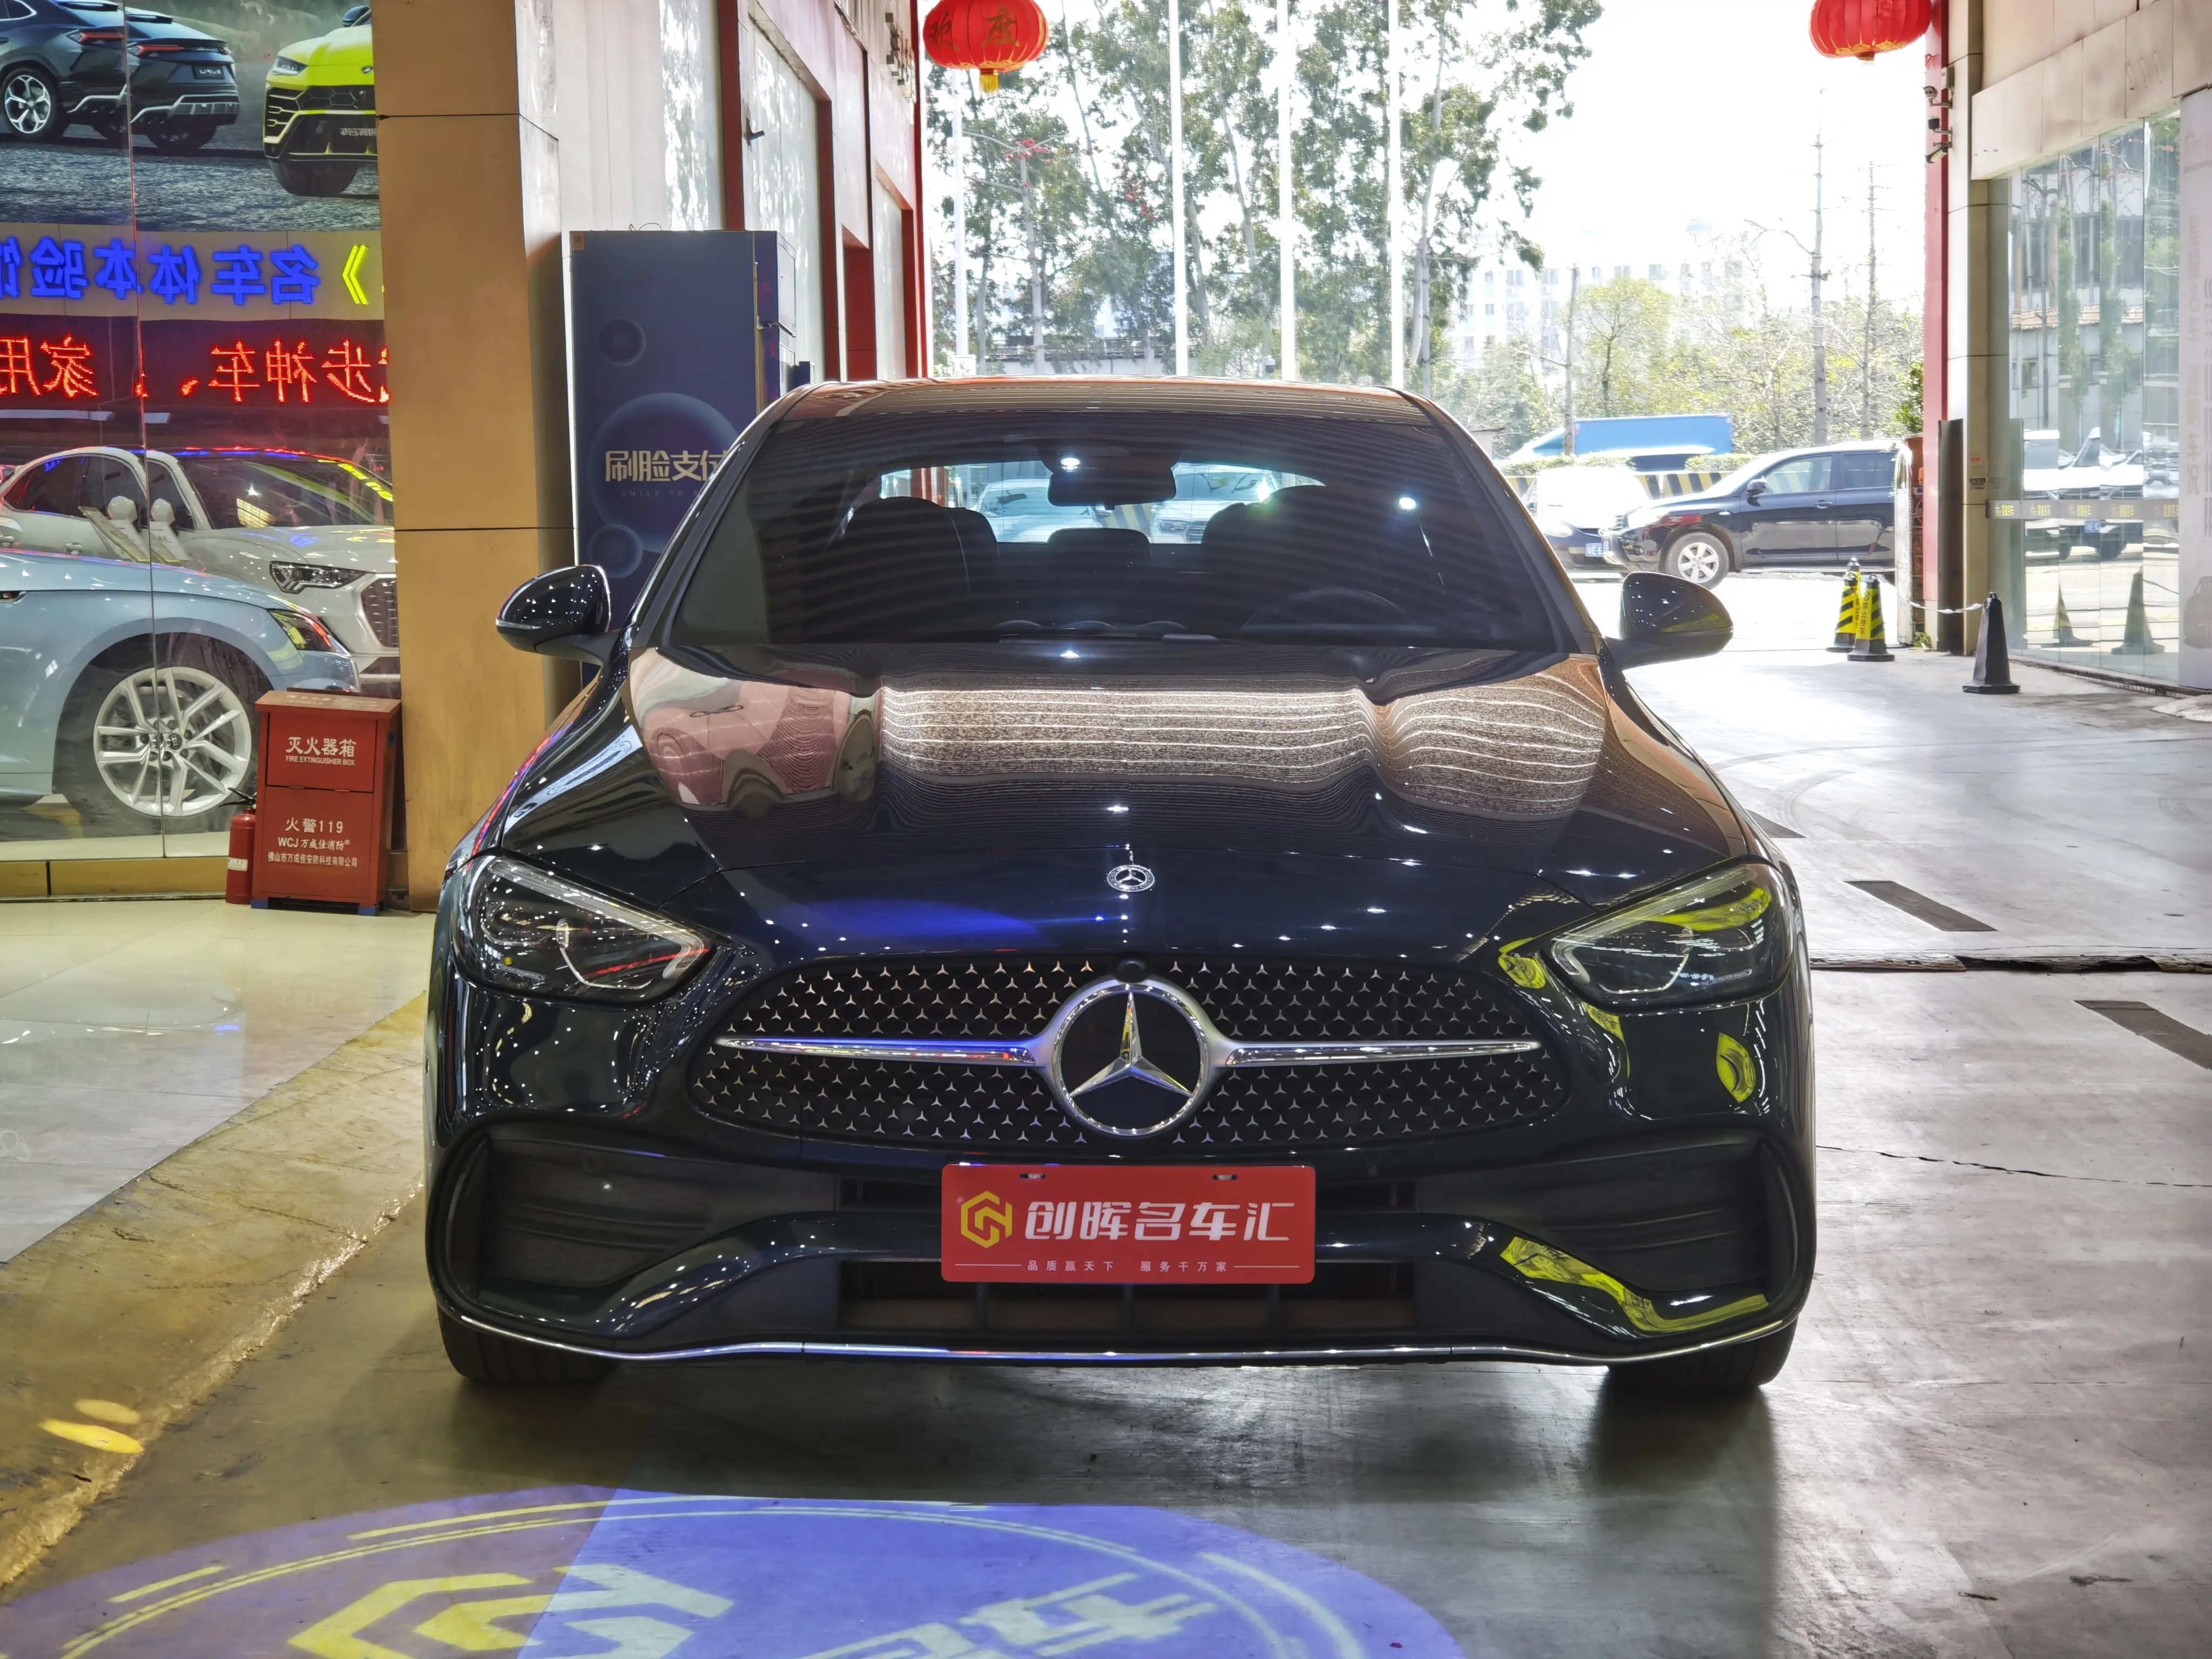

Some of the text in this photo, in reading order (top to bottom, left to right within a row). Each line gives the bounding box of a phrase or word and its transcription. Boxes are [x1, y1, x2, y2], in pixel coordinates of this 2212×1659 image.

[285, 737, 356, 758] 灭火器箱
[299, 756, 341, 765] EXTINGUISHER
[1025, 1201, 1295, 1241] 创晖名车汇
[1027, 1260, 1227, 1272] 品质赢天下 服务千万家
